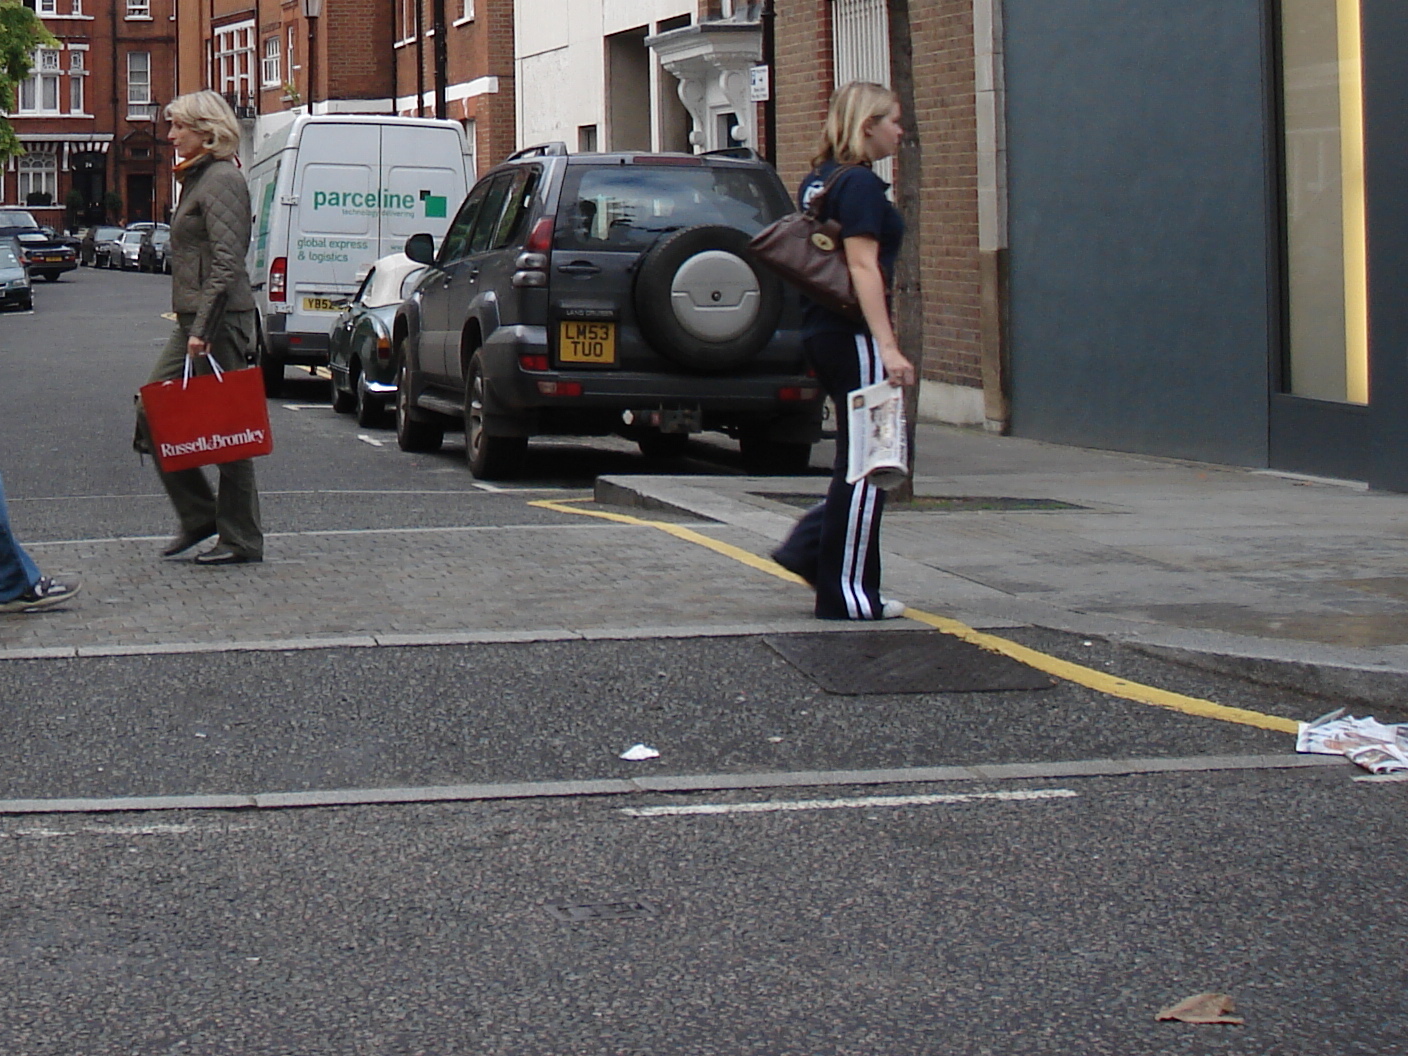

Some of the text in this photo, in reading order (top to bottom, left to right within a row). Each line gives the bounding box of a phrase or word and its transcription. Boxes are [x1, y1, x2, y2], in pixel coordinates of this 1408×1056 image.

[313, 188, 415, 210] parceline
[297, 237, 369, 251] global express
[297, 250, 349, 264] & logistics
[565, 324, 610, 341] LM53
[571, 341, 603, 358] TUO
